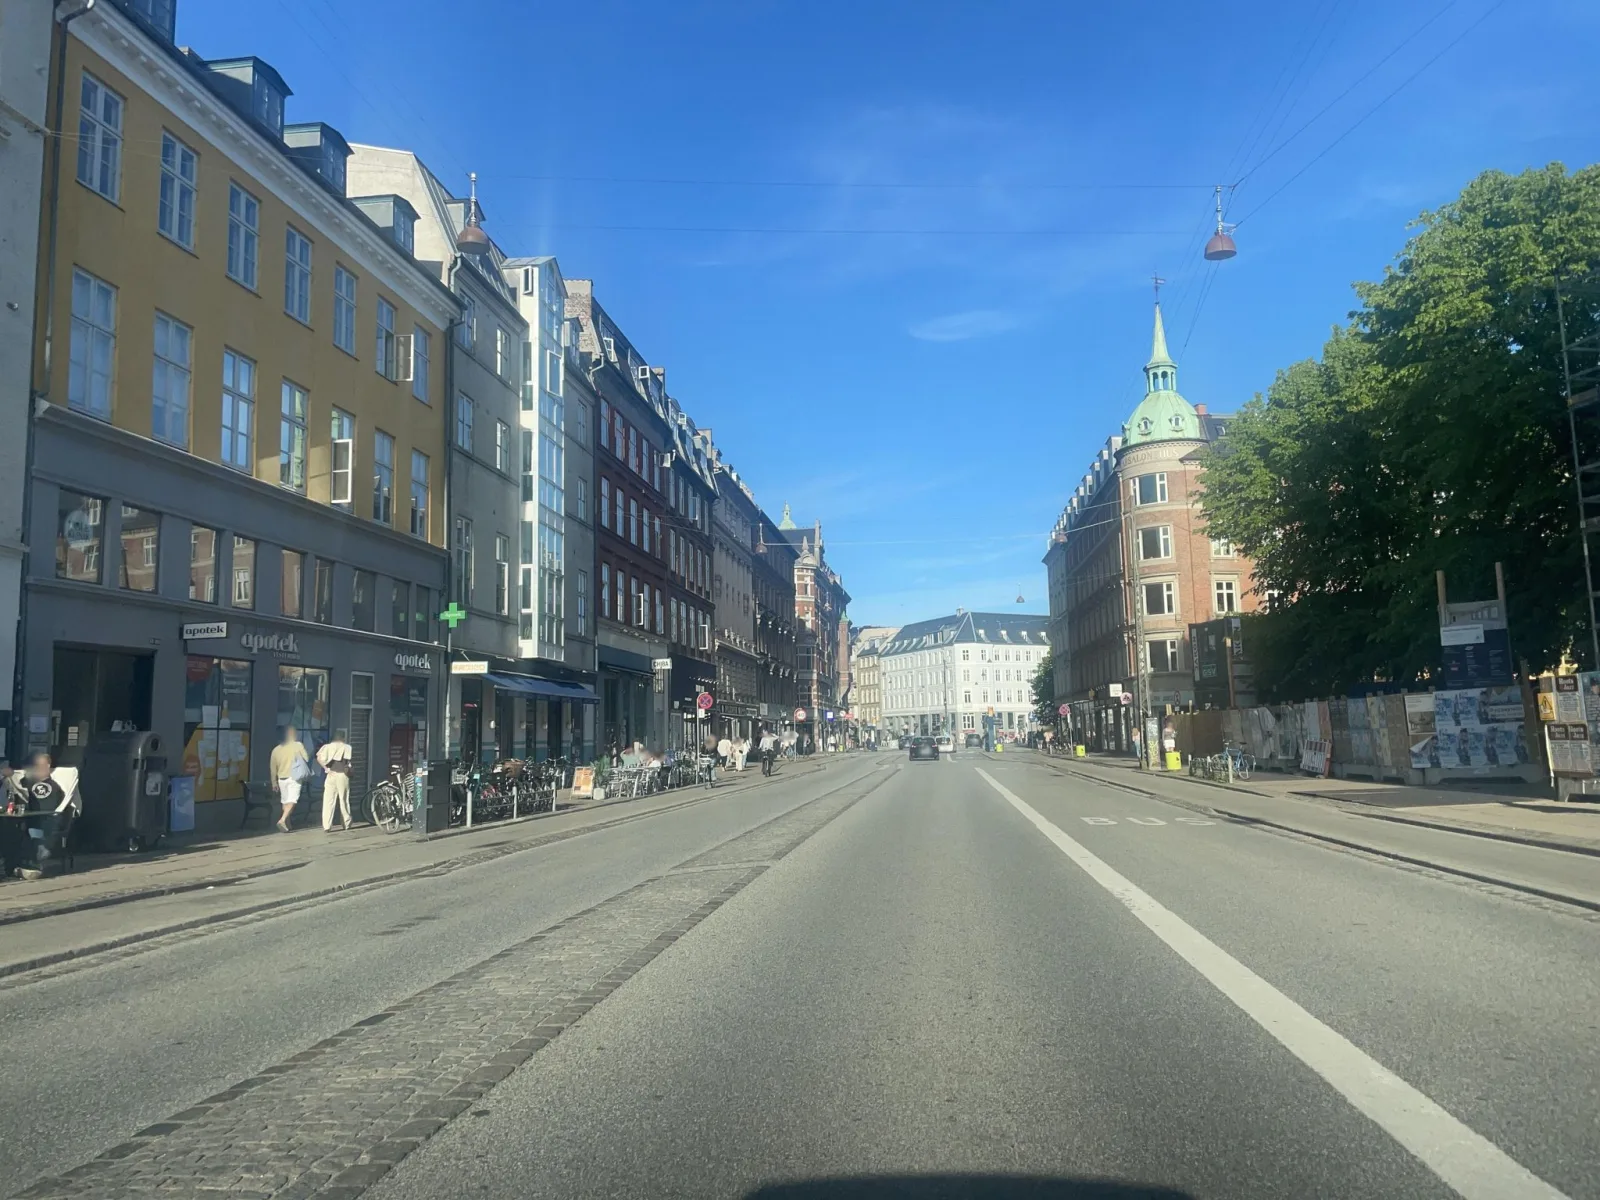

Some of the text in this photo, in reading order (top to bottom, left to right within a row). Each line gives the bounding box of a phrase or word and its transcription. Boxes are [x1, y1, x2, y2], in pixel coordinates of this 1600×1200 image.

[185, 625, 224, 637] apotek
[241, 633, 299, 654] apotek
[395, 653, 431, 671] apotek
[1080, 817, 1217, 827] BUS
